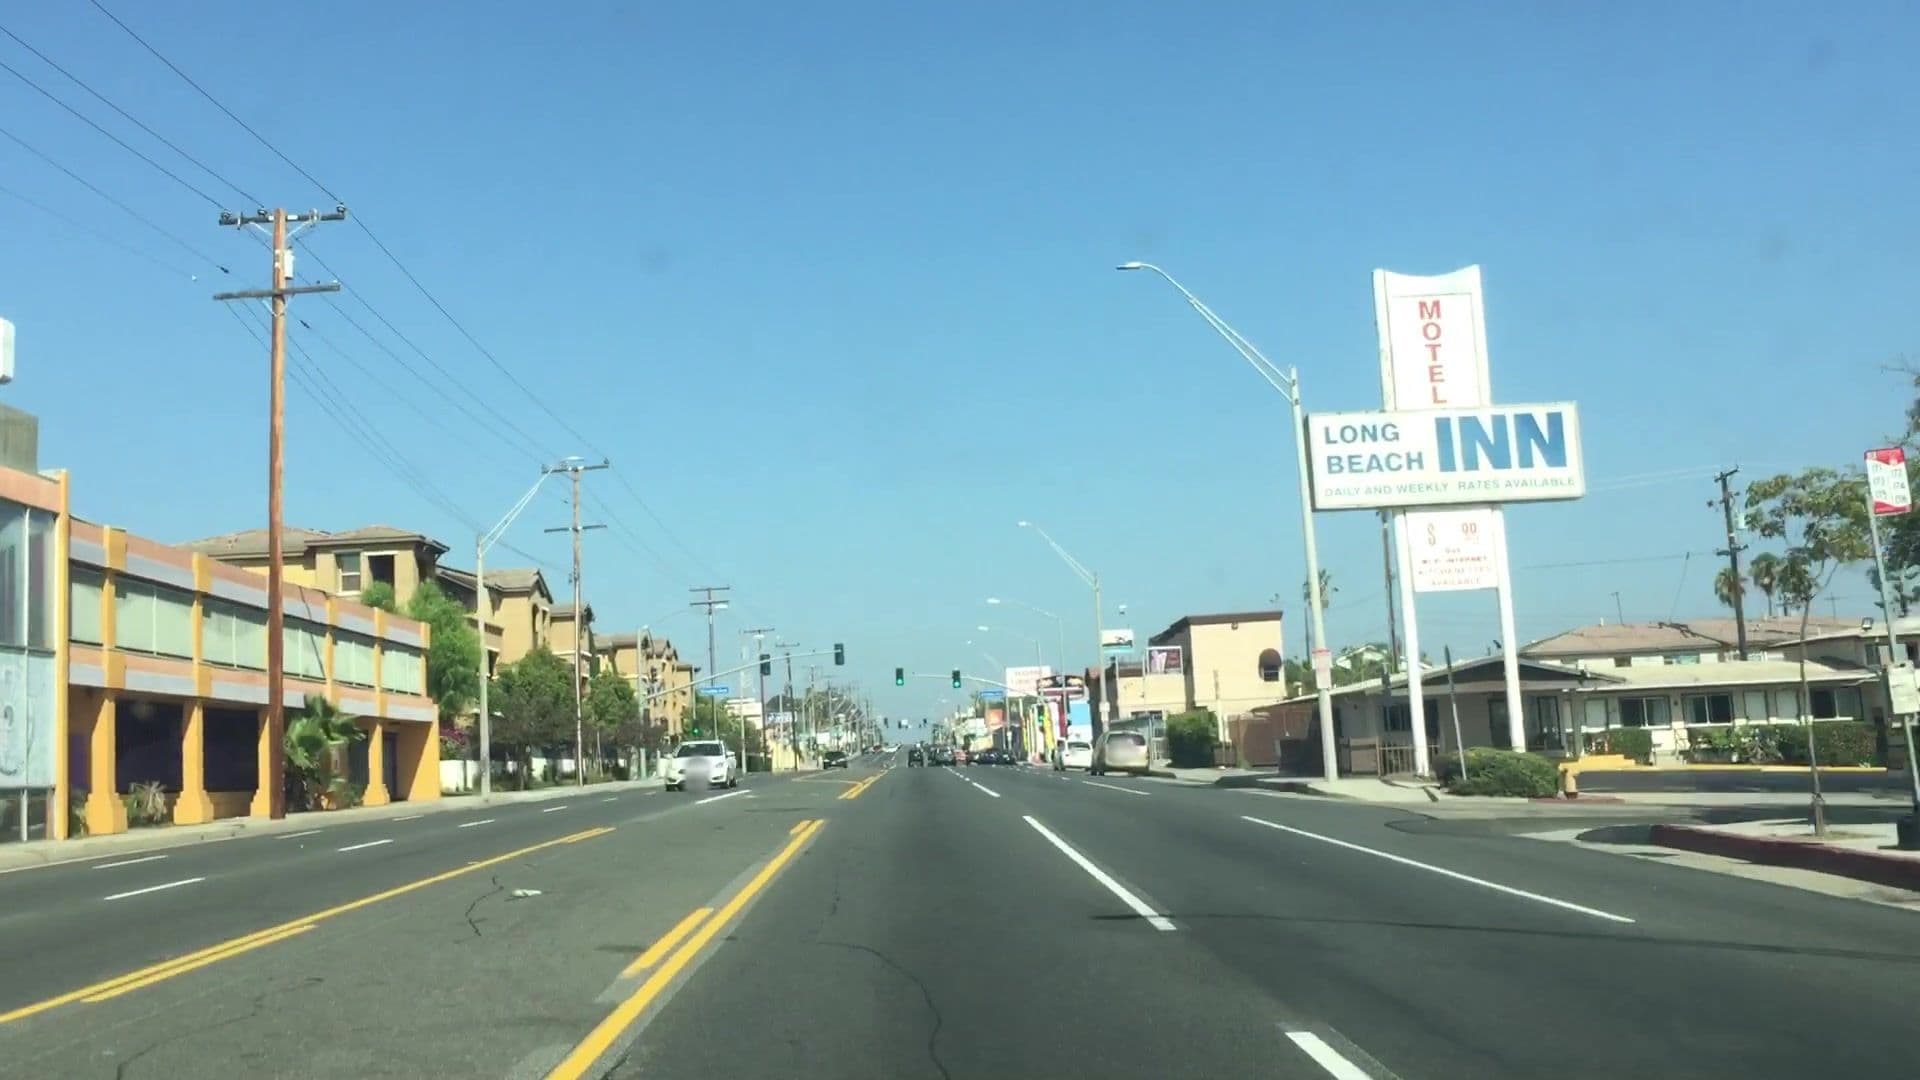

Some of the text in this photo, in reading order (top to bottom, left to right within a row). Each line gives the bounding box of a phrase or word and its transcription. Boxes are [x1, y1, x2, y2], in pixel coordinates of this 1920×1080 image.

[1418, 300, 1448, 404] MOTEL
[1324, 423, 1400, 445] LONG
[1434, 411, 1567, 473] INN
[1326, 451, 1425, 475] BEACH
[1324, 477, 1575, 497] DAILY AND WEEKLY RATES AVAILABLE
